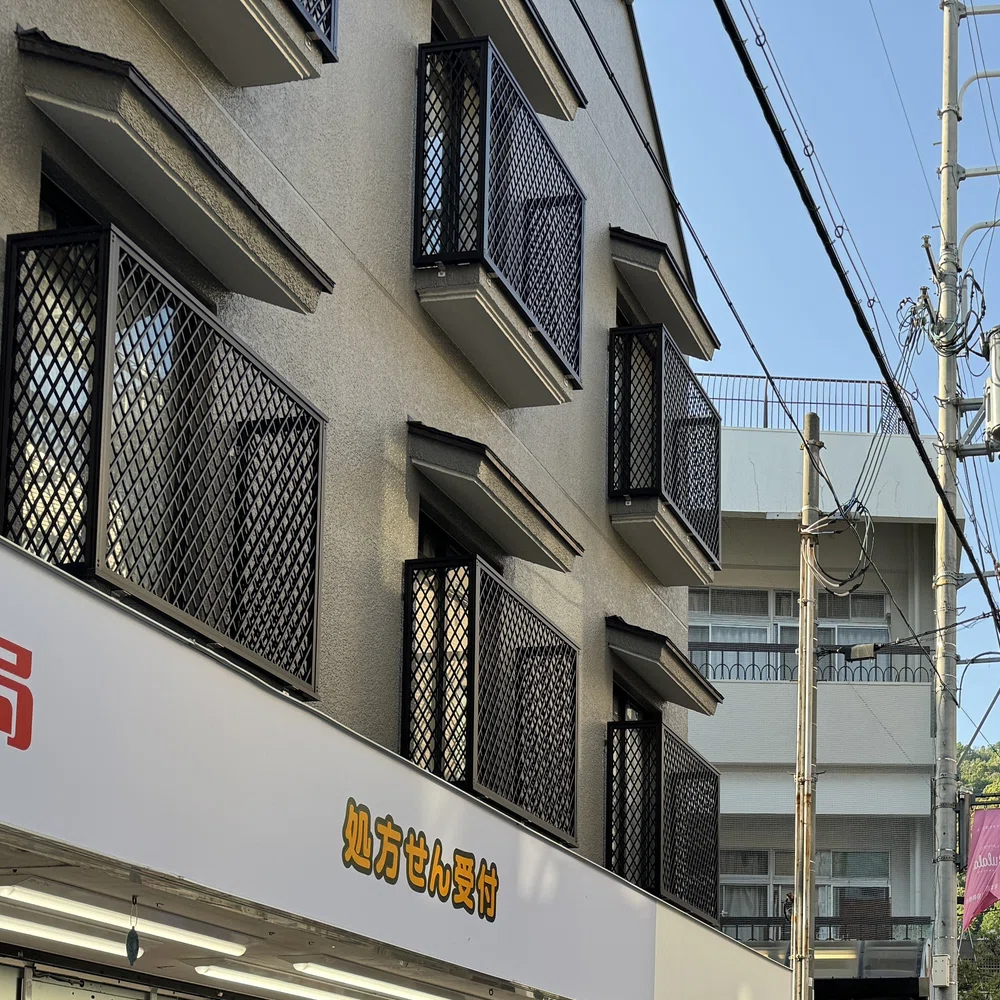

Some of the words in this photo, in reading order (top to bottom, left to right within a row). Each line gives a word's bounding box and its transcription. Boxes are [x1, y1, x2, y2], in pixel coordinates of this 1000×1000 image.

[342, 797, 499, 923] 処方せん受付
